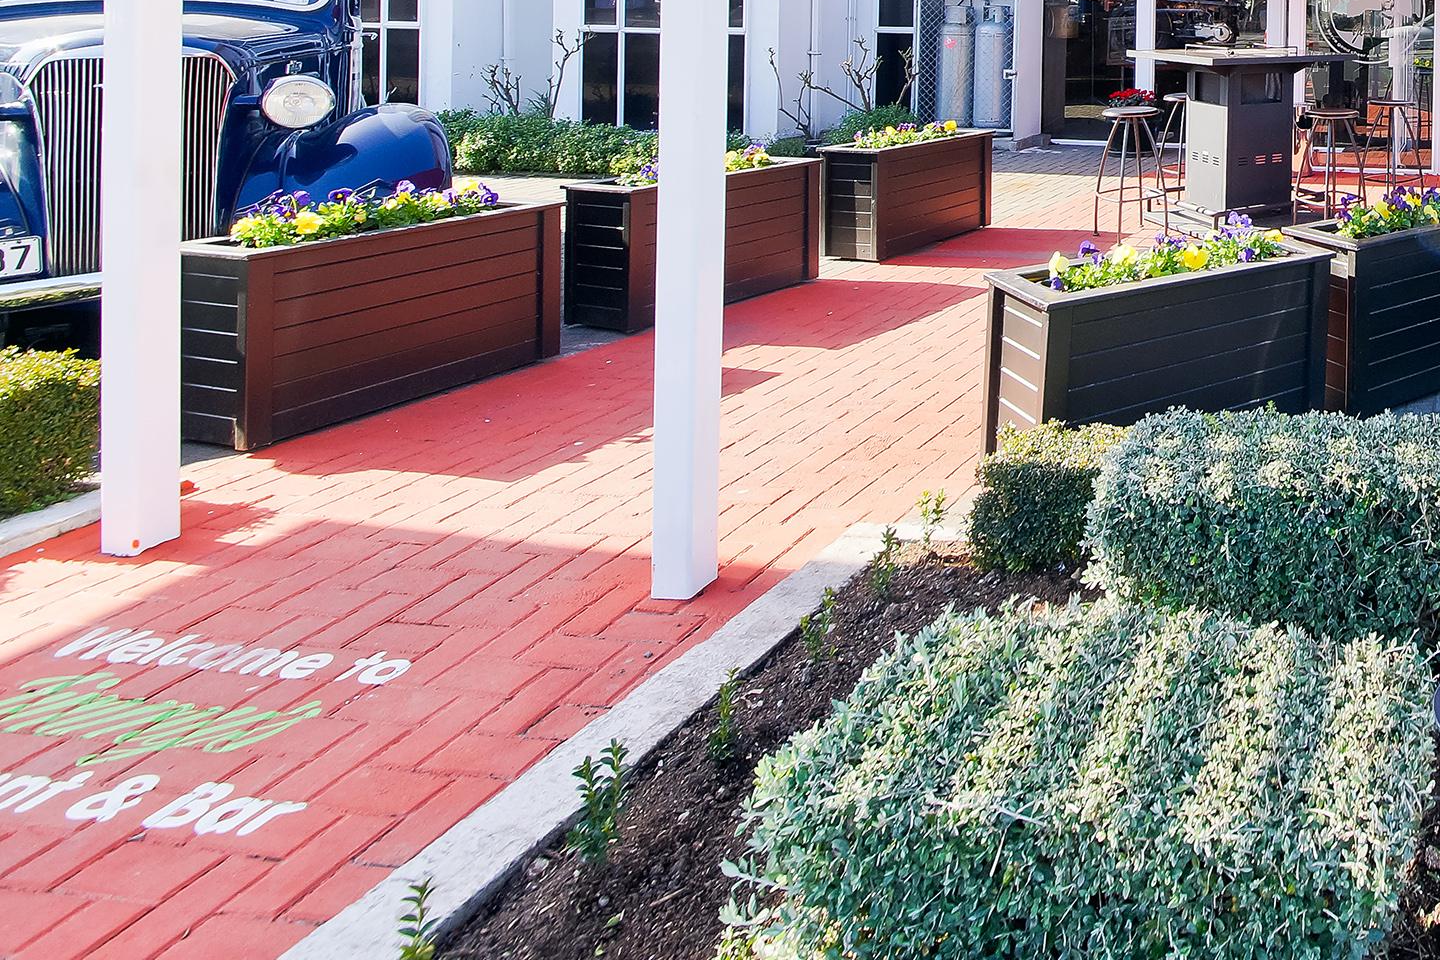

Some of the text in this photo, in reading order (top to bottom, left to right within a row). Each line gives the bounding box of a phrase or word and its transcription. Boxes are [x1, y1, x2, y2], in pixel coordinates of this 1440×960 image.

[54, 626, 412, 685] Welcome to
[65, 774, 160, 822] &
[141, 781, 307, 836] Bar
